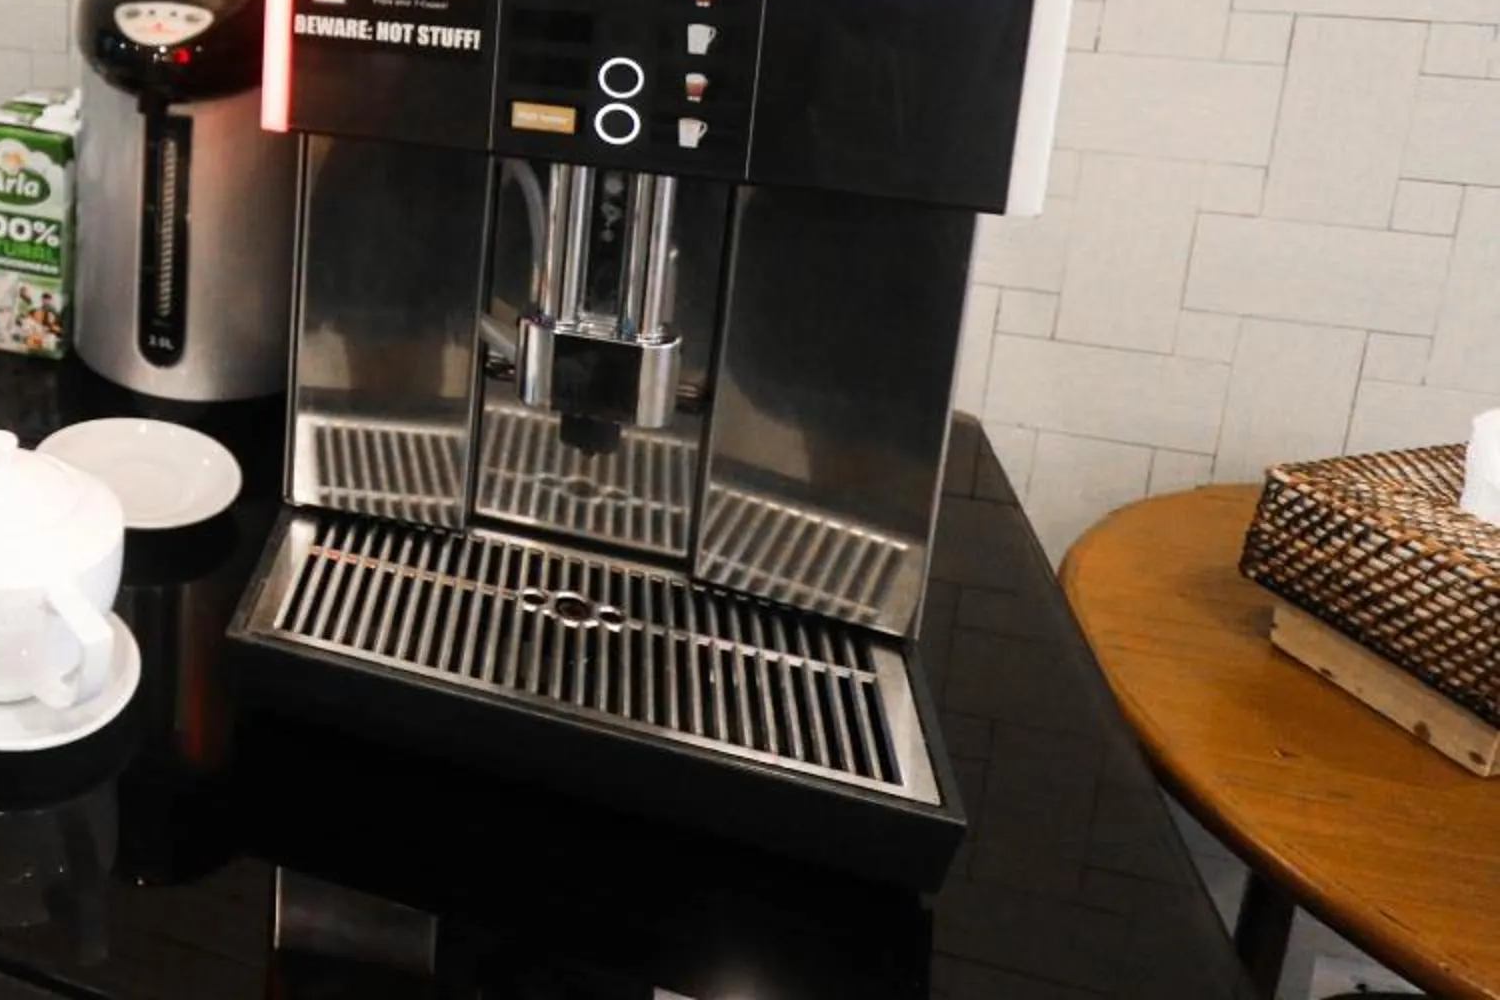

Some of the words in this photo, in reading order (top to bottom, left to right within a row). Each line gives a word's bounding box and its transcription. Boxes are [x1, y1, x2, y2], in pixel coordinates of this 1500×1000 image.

[294, 14, 373, 40] BEWARE:
[376, 21, 414, 44] HOT
[417, 25, 481, 50] STUFF!
